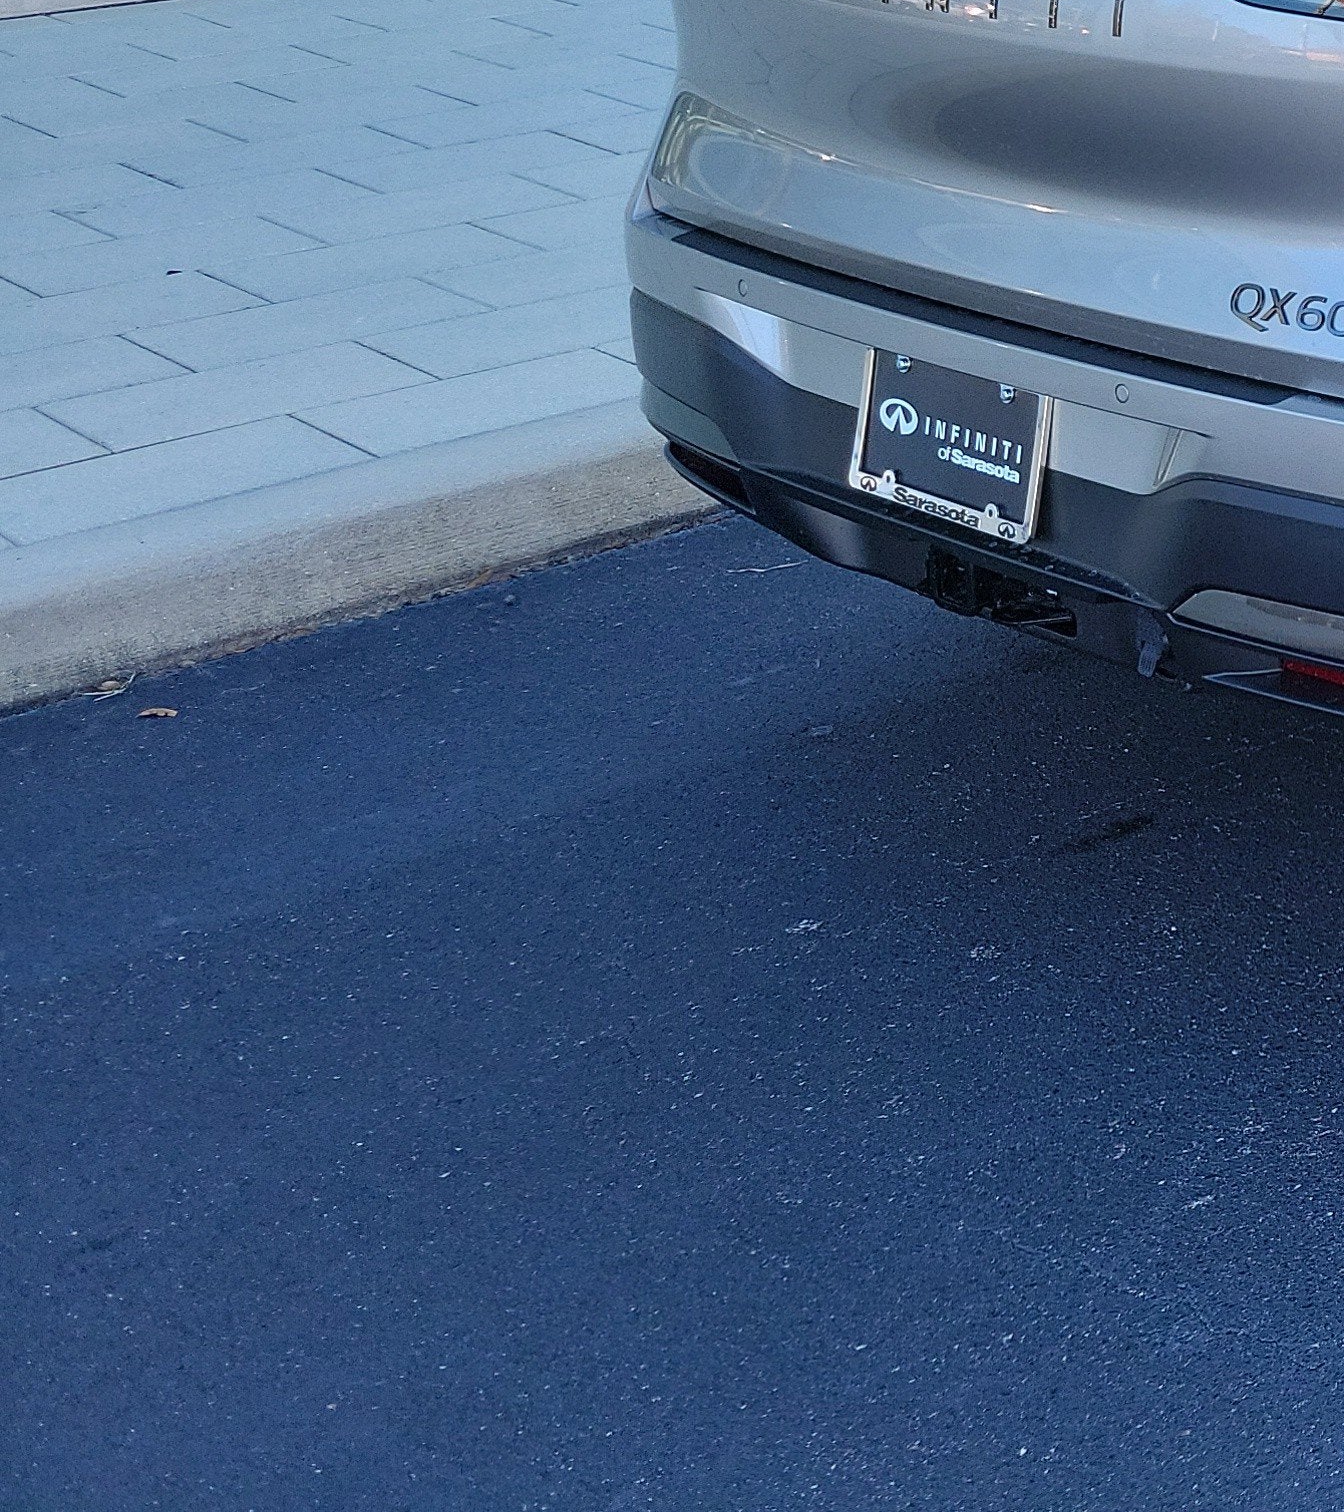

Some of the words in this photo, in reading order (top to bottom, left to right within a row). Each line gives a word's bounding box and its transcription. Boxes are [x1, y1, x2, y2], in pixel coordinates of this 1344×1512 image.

[924, 415, 1024, 464] INFINITI
[937, 446, 951, 462] of
[949, 450, 1021, 484] Sarasota
[892, 485, 981, 530] Sarasota
